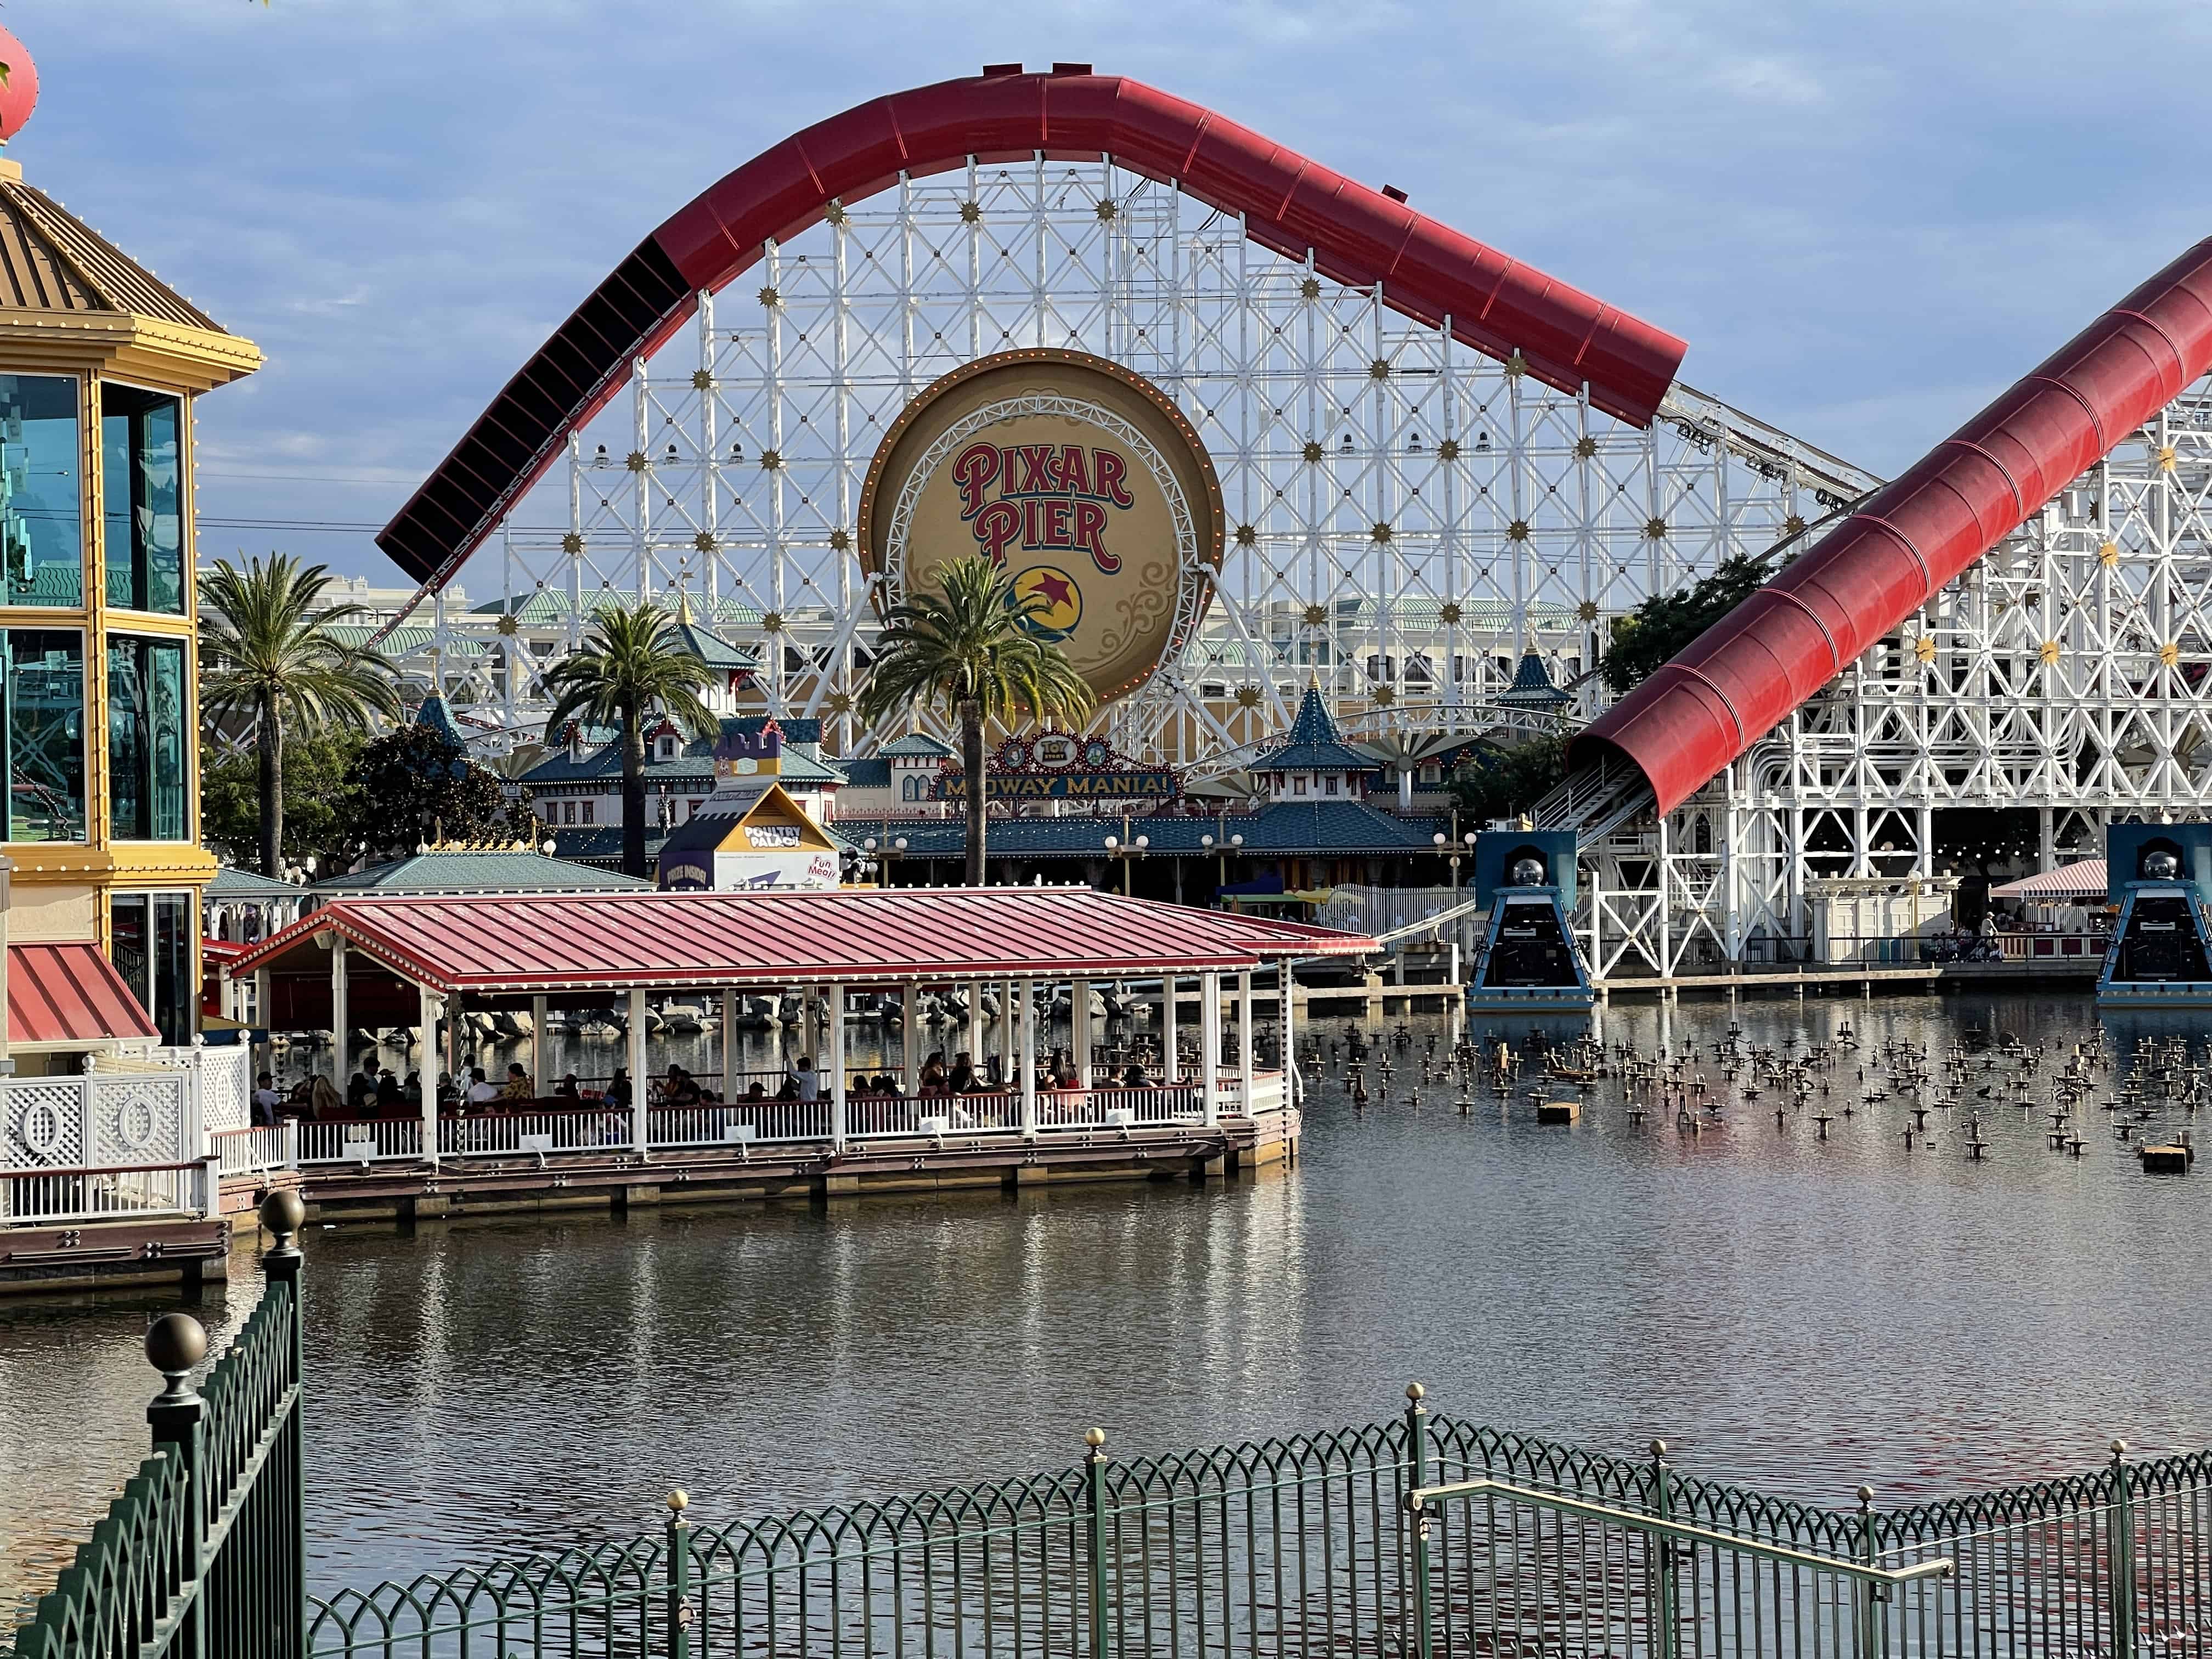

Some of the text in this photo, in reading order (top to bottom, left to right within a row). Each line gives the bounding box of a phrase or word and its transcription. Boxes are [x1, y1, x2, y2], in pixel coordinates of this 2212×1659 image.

[952, 442, 1134, 521] PIXAR
[973, 498, 1122, 575] PIER
[1041, 741, 1068, 753] TOY
[944, 776, 1167, 795] MDWAY MANIA!
[743, 825, 802, 838] POULTRY
[750, 835, 802, 848] PALACE
[814, 855, 832, 869] Fun
[667, 865, 684, 885] PRIZE
[808, 865, 836, 880] Meal!
